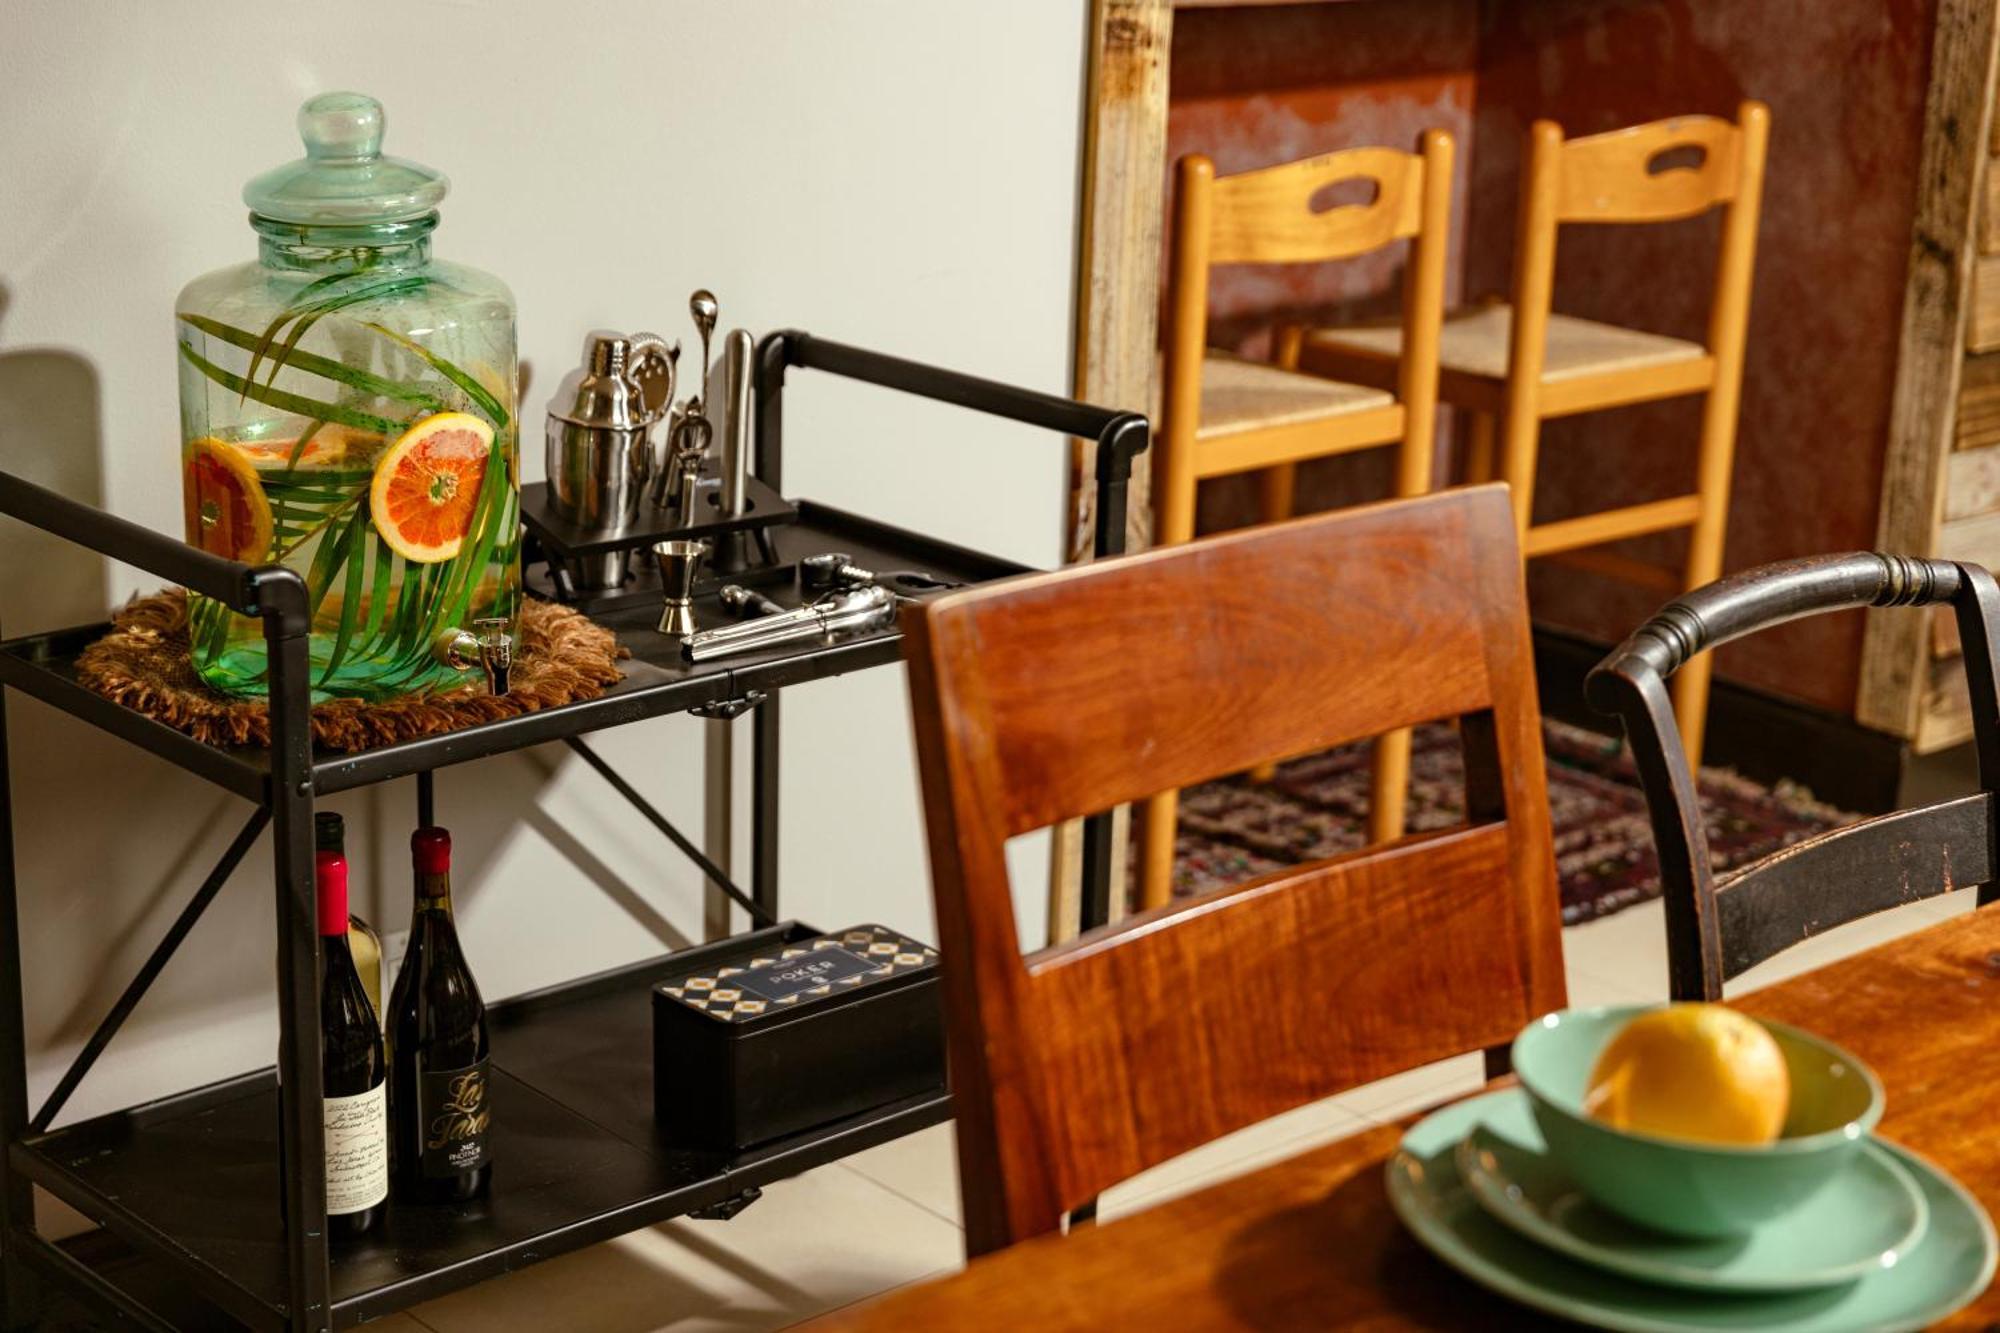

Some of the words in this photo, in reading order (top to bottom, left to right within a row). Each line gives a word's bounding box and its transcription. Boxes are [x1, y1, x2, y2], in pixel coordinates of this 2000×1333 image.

[769, 960, 835, 984] POKER
[443, 1071, 486, 1113] Las
[428, 1106, 490, 1149] Jara
